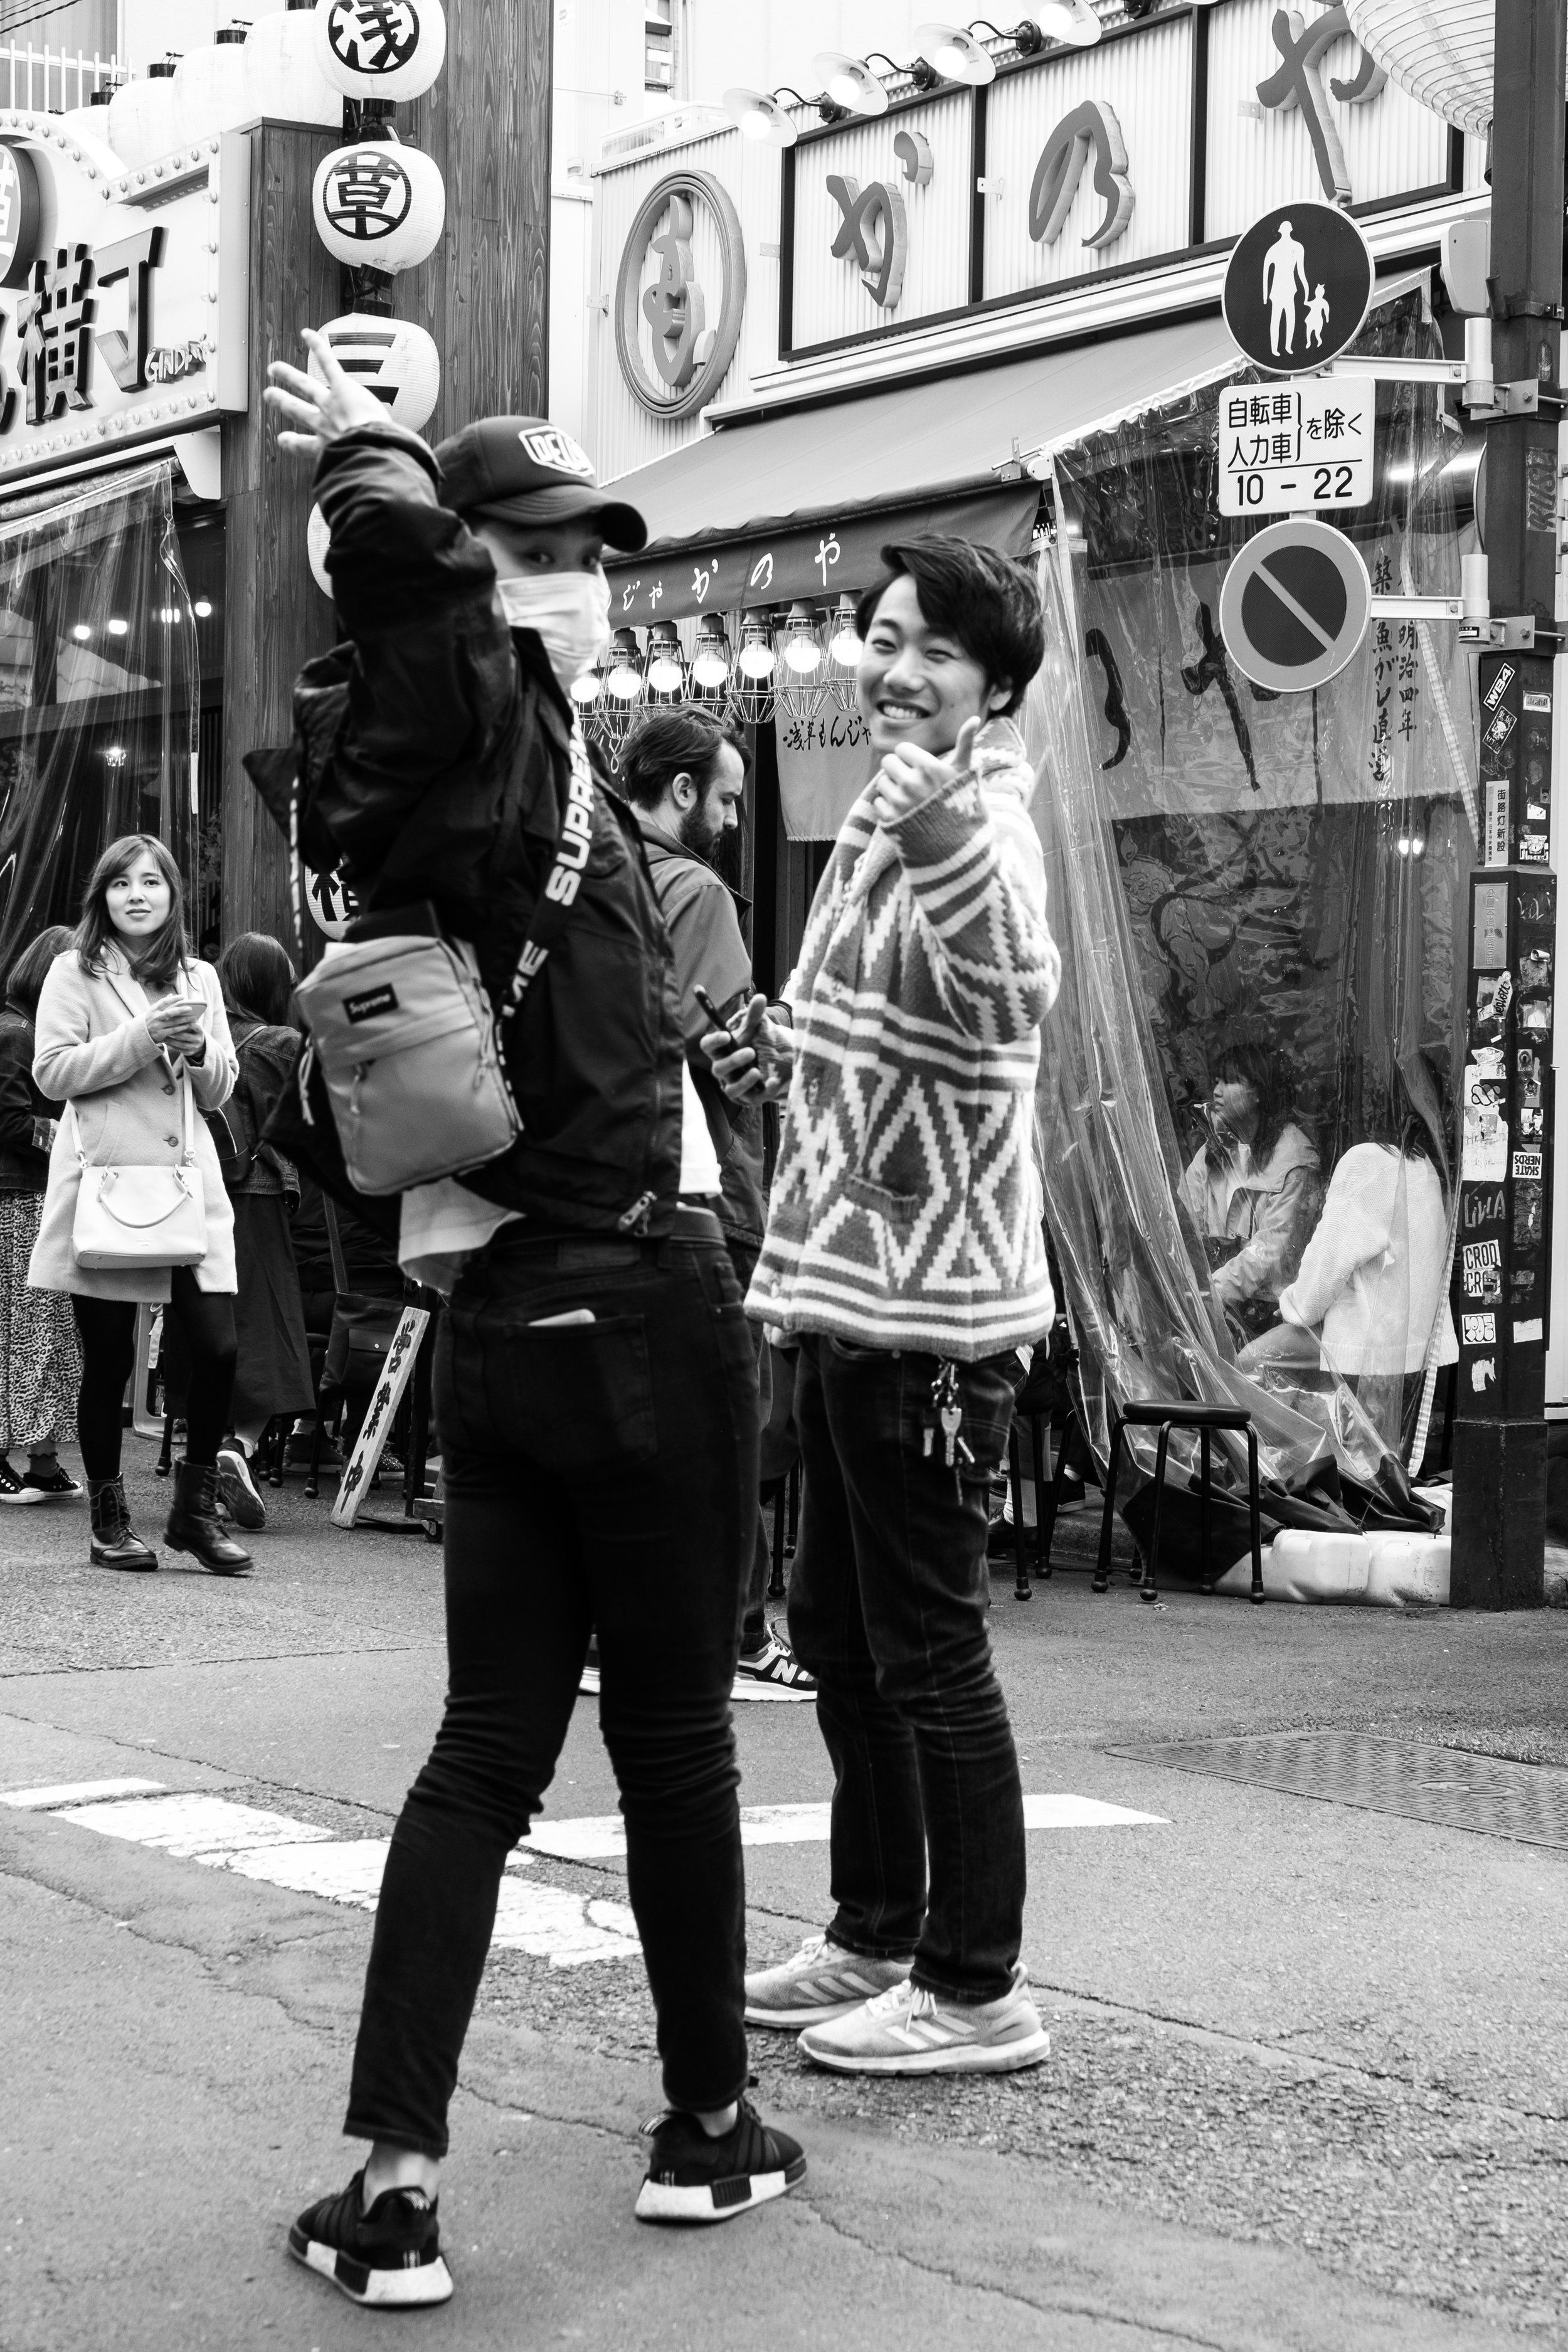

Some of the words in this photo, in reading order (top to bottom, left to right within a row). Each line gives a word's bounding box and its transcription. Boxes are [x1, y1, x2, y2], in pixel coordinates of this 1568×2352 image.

[324, 152, 411, 240] 草
[0, 226, 164, 433] 横丁
[1229, 393, 1292, 428] 自転車
[1306, 408, 1362, 441] を除く
[1227, 432, 1292, 468] 人力車
[1237, 474, 1264, 506] 10
[1313, 466, 1353, 500] 22
[607, 532, 841, 612] じゃかのや
[1369, 555, 1400, 782] 築魚がし直営
[1486, 668, 1512, 706] WB4
[783, 715, 872, 751] 浅草もんじゃ
[1496, 789, 1507, 852] 街路灯新設
[348, 993, 392, 1015] Supreme
[1514, 1155, 1541, 1165] NERDS
[1515, 1165, 1539, 1175] SKATE
[340, 1318, 416, 1513] 営業中
[771, 1659, 798, 1684] N
